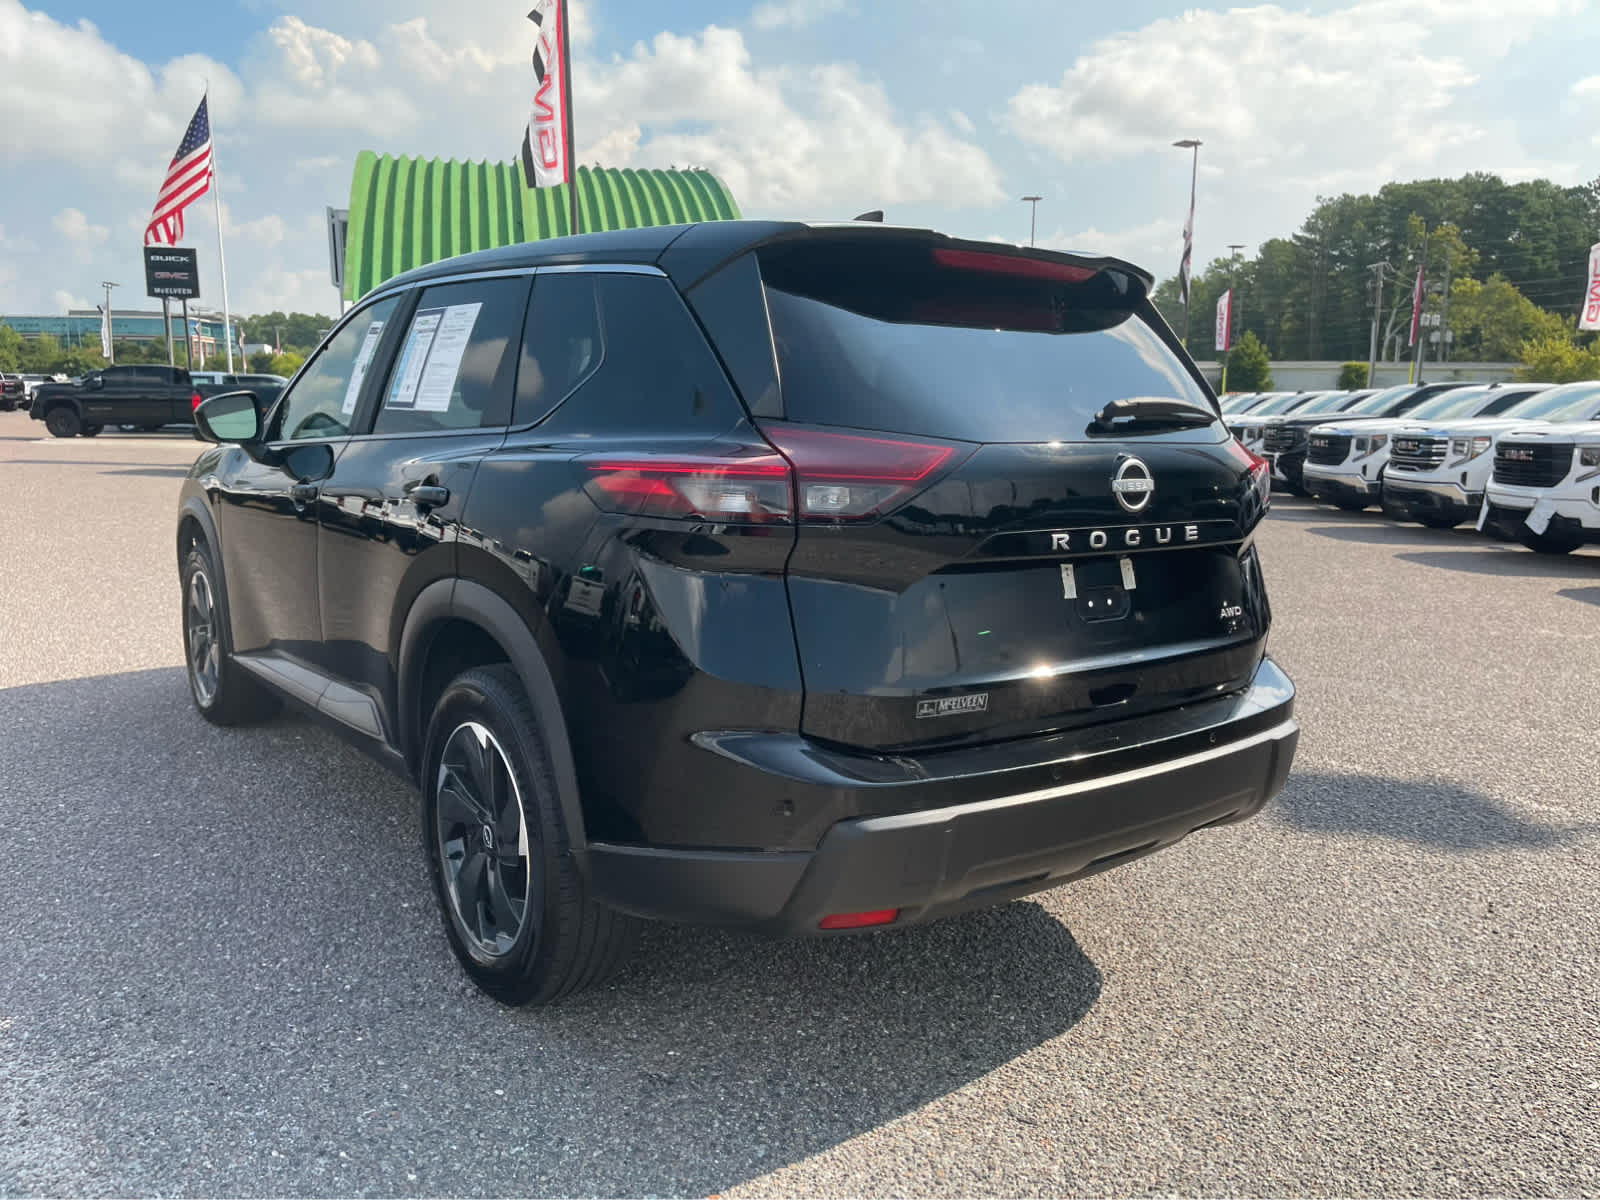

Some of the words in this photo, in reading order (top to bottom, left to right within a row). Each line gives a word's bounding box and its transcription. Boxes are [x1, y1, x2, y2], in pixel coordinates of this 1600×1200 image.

[154, 272, 189, 280] GMC
[1112, 479, 1154, 491] NISSAN
[1051, 525, 1200, 550] ROGUE
[1219, 606, 1242, 619] AWD
